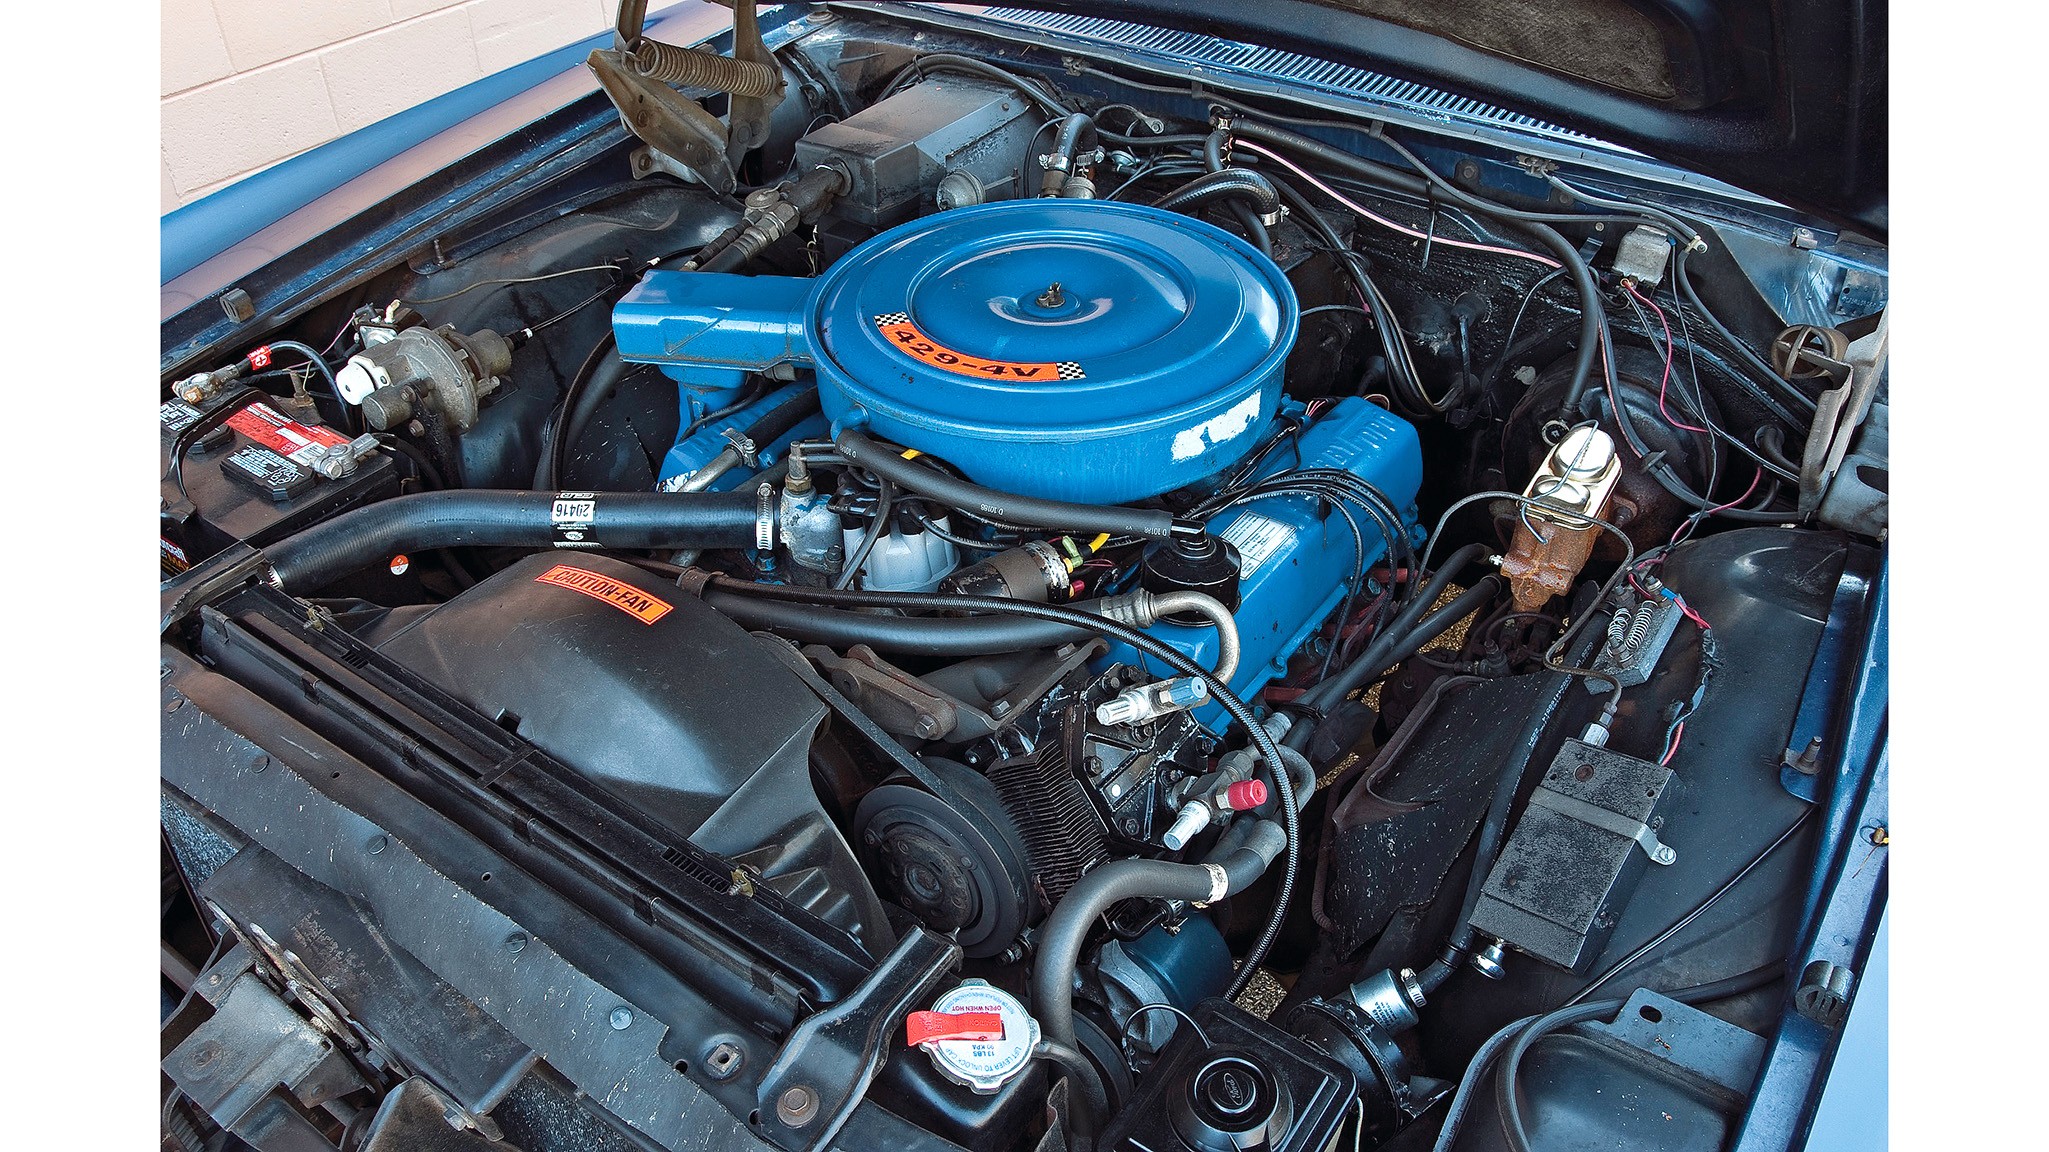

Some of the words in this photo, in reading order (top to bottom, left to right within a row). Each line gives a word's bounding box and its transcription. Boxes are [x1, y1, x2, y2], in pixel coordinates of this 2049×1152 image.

[894, 329, 1041, 378] 429-4V
[555, 503, 591, 518] 20416
[553, 570, 654, 613] CAUTION-FAN
[984, 1064, 993, 1072] TO
[993, 1056, 1013, 1071] LEVER
